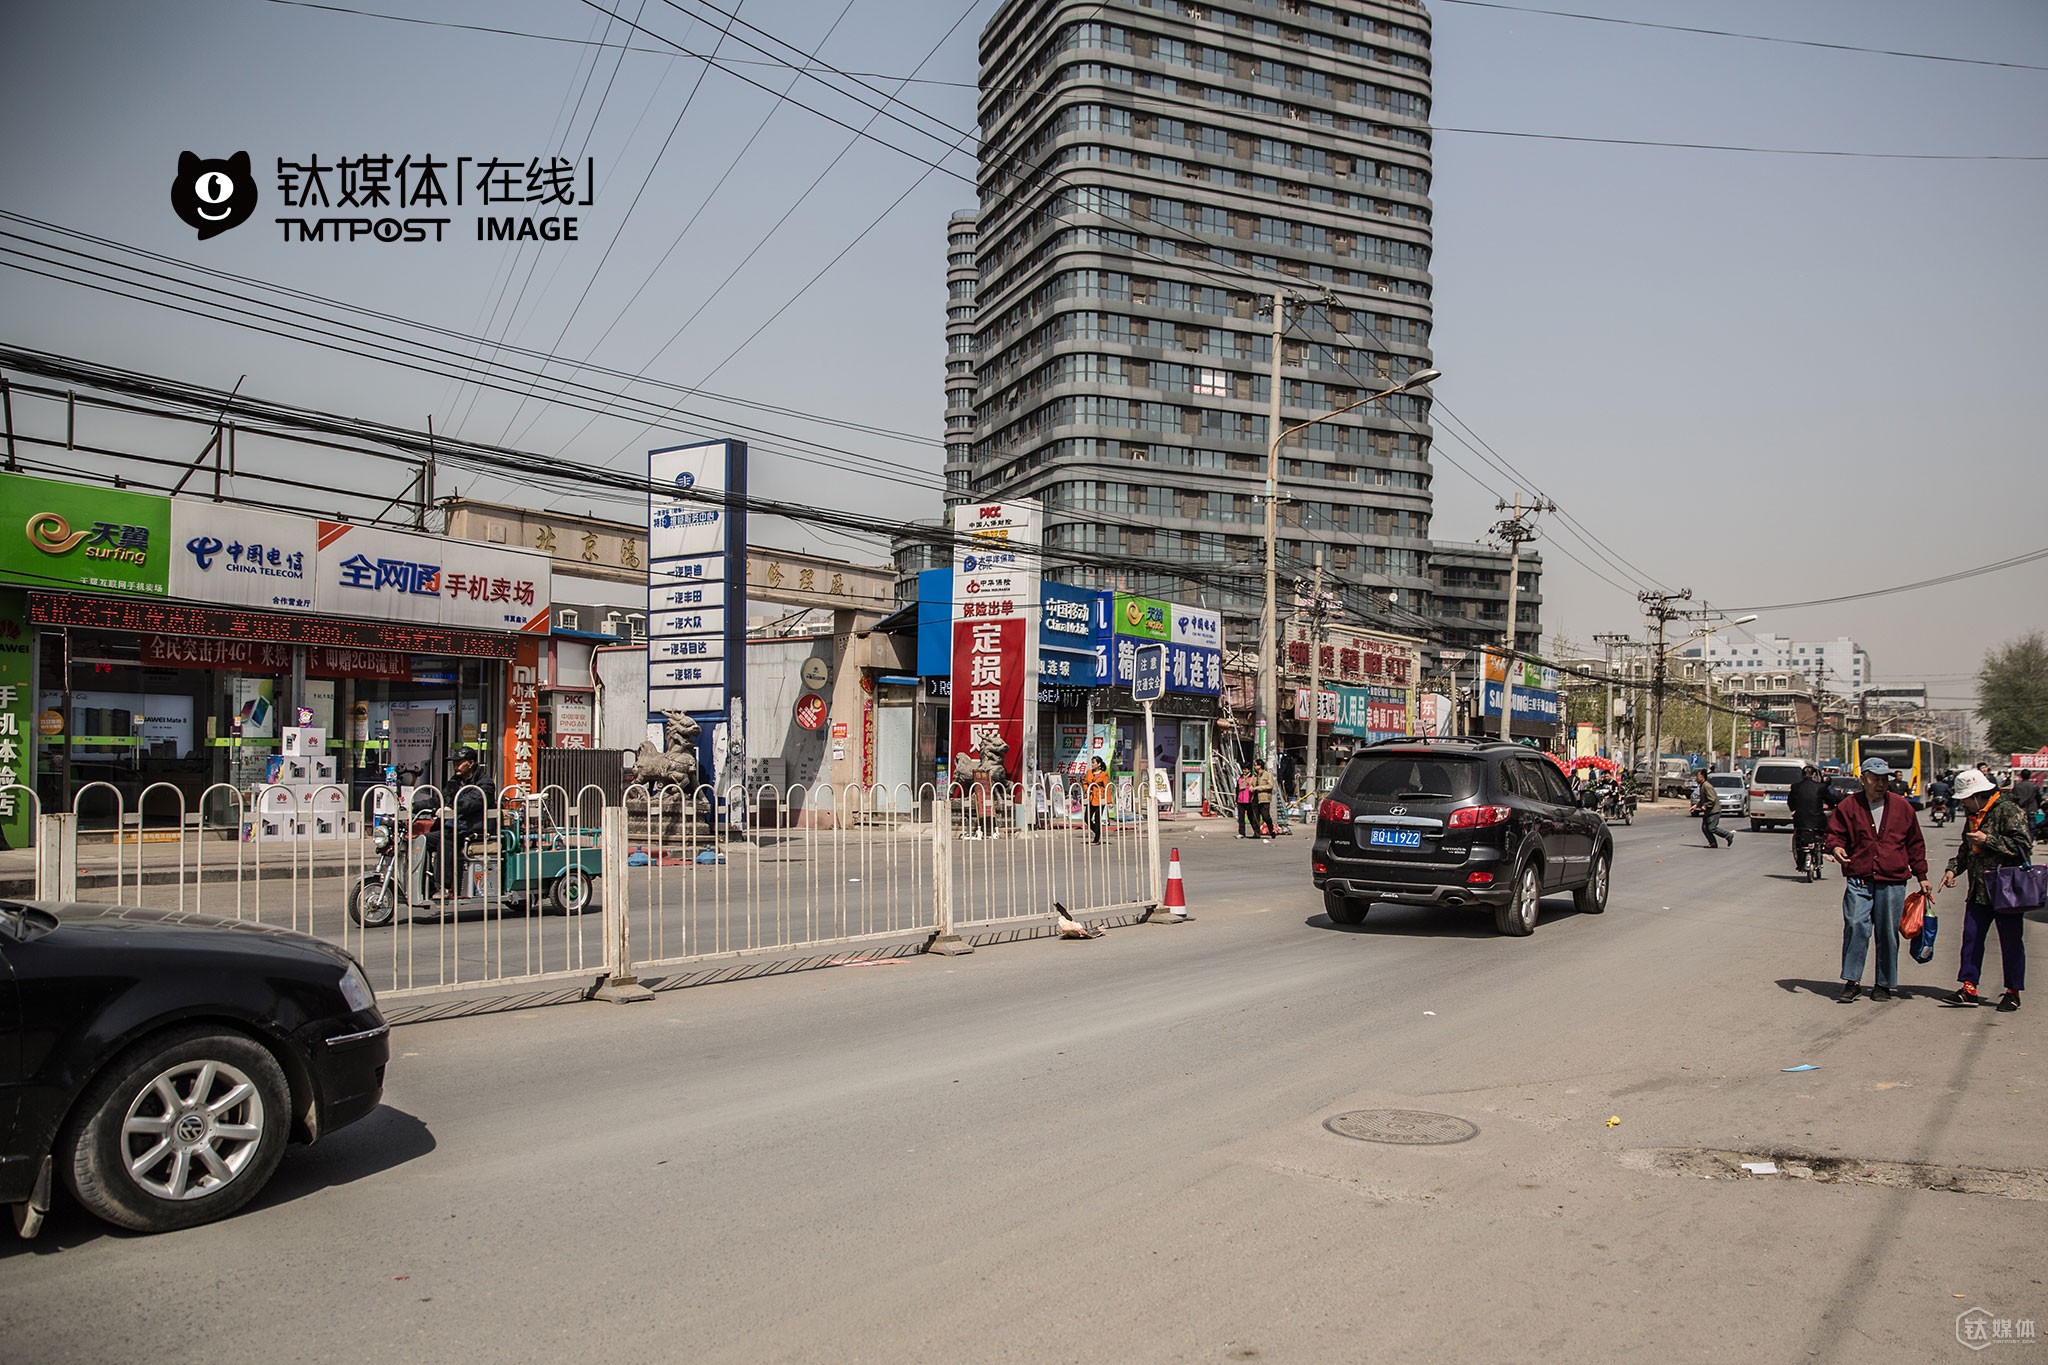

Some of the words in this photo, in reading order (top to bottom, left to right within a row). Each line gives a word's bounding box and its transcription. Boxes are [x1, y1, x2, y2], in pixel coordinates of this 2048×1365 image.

[980, 506, 1001, 519] PICC
[87, 520, 149, 549] 天翼
[85, 546, 146, 566] surfing
[226, 540, 304, 573] 中国电信
[226, 563, 257, 575] CHINA
[259, 567, 304, 580] TELECOM
[339, 554, 441, 596] 全网通
[667, 564, 702, 577] 一汽奥迪
[445, 573, 535, 606] 手机卖场
[666, 590, 702, 603] 一汽丰田
[272, 596, 311, 607] 合作营业厅
[963, 600, 1013, 617] 保险出单
[1046, 598, 1089, 621] 中国移动
[666, 616, 702, 629] 一汽大众
[1046, 619, 1066, 632] China
[1067, 622, 1089, 635] Mobile
[1191, 616, 1216, 632] 中国电信
[663, 642, 706, 655] 一汽马自达
[1140, 657, 1157, 671] 注意
[666, 669, 702, 680] 一汽轿车
[513, 684, 536, 698] 小米
[970, 623, 1002, 753] 定损理赔
[1137, 676, 1160, 692] 交通安全
[564, 695, 583, 704] PICC
[1064, 738, 1103, 748] 分期款
